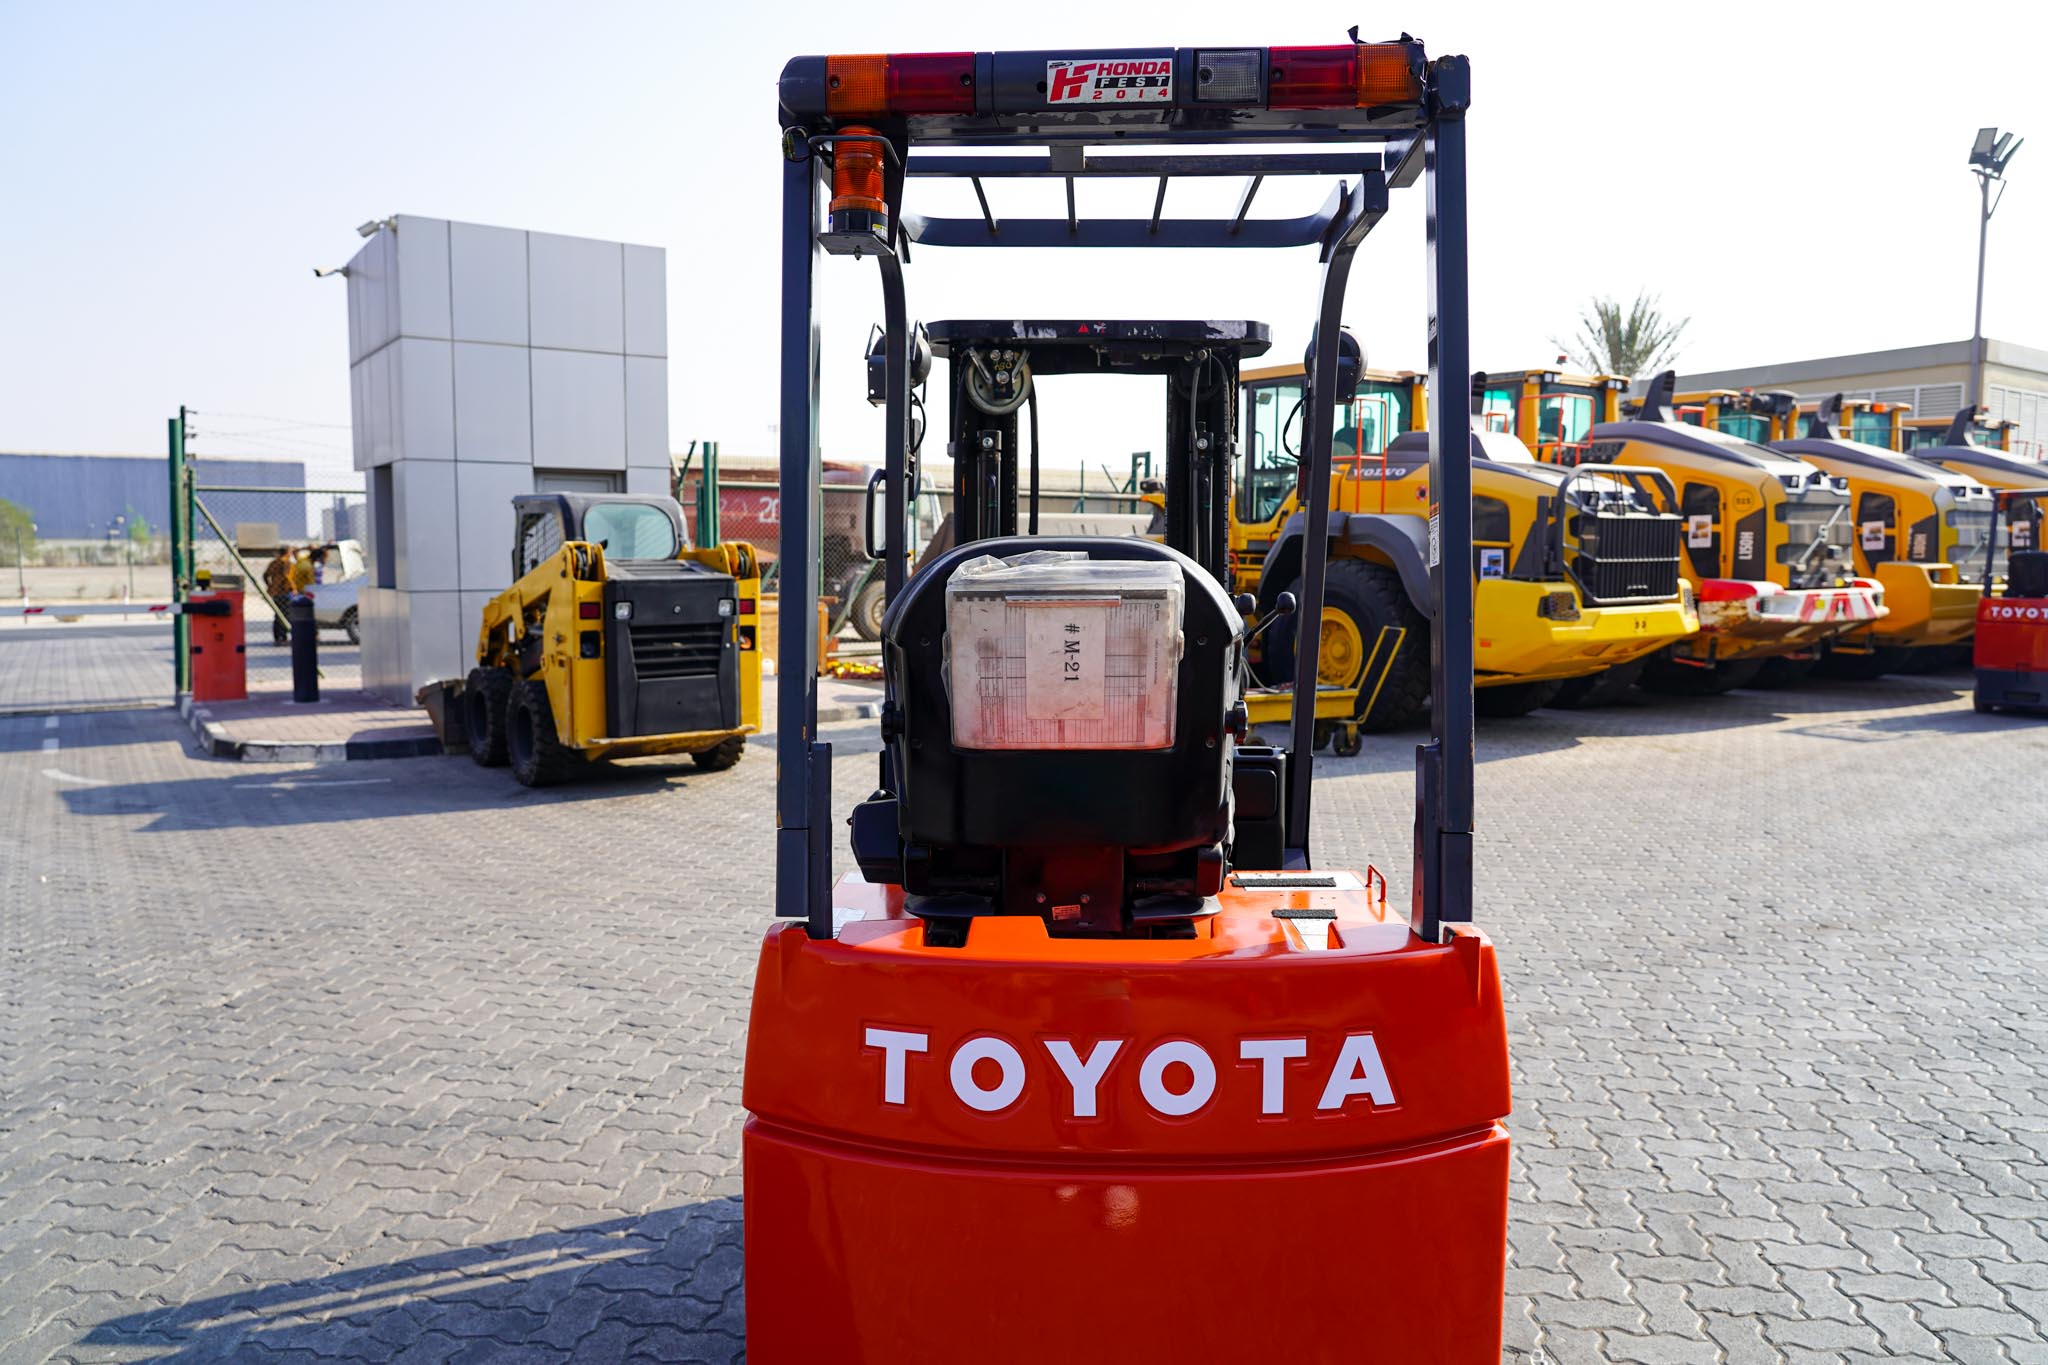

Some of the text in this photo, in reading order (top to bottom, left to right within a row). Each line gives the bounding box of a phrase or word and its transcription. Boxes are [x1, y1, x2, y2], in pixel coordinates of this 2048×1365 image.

[1097, 61, 1170, 76] HONDA
[1100, 76, 1166, 88] FEST
[1093, 88, 1168, 100] 2014
[1353, 467, 1407, 477] VOLVO
[1064, 623, 1080, 682] # M-21
[865, 1027, 1397, 1117] TOYOTA
